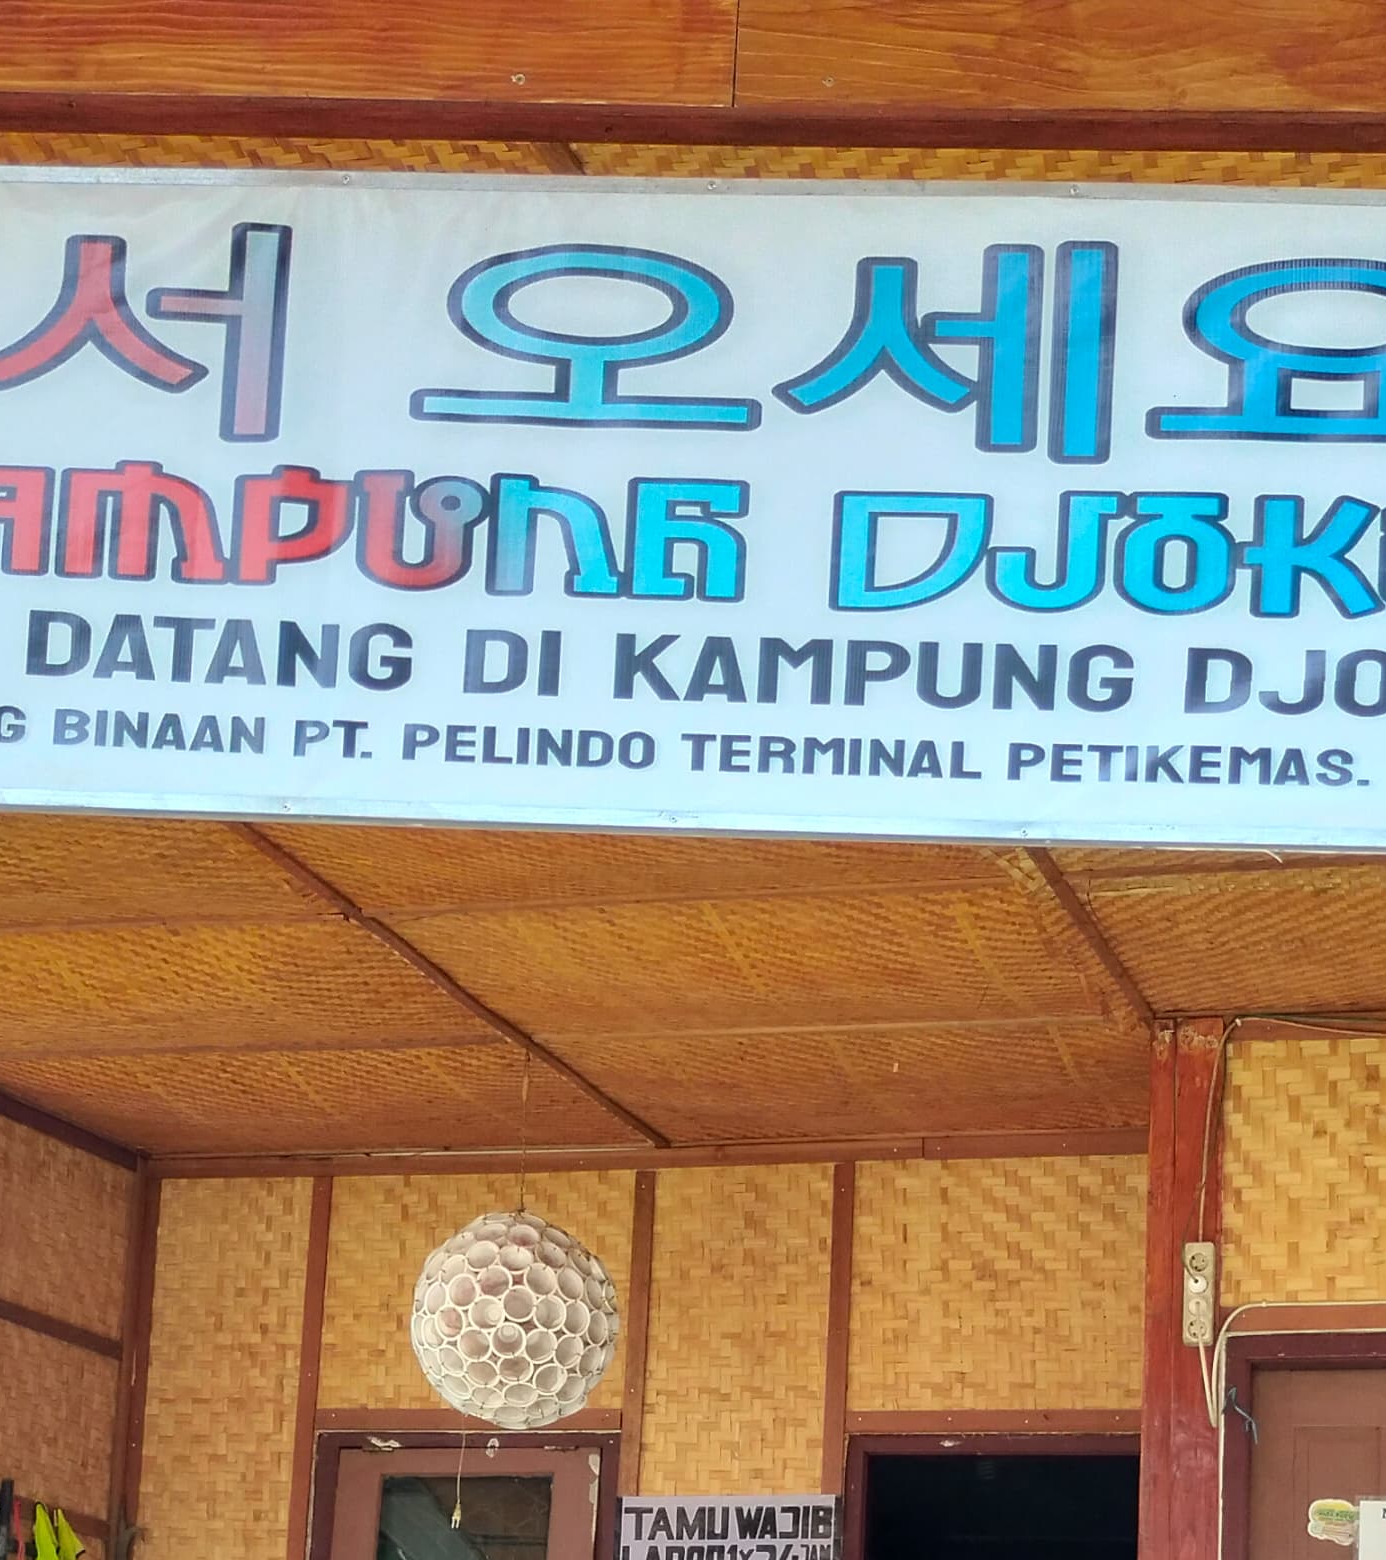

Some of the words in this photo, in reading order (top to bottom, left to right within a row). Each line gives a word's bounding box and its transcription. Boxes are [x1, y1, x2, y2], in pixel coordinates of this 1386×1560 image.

[25, 609, 411, 692] DATANG
[463, 628, 561, 697] DI
[612, 633, 1134, 714] KAMPUNG
[51, 706, 265, 756] BINAAN
[291, 718, 373, 760] PT.
[401, 723, 657, 771] PELINDO
[680, 732, 983, 781] TERMINAL
[1007, 740, 1372, 789] PETIKEMAS.
[624, 1506, 729, 1541] TAMU
[735, 1505, 834, 1540] WAJIB
